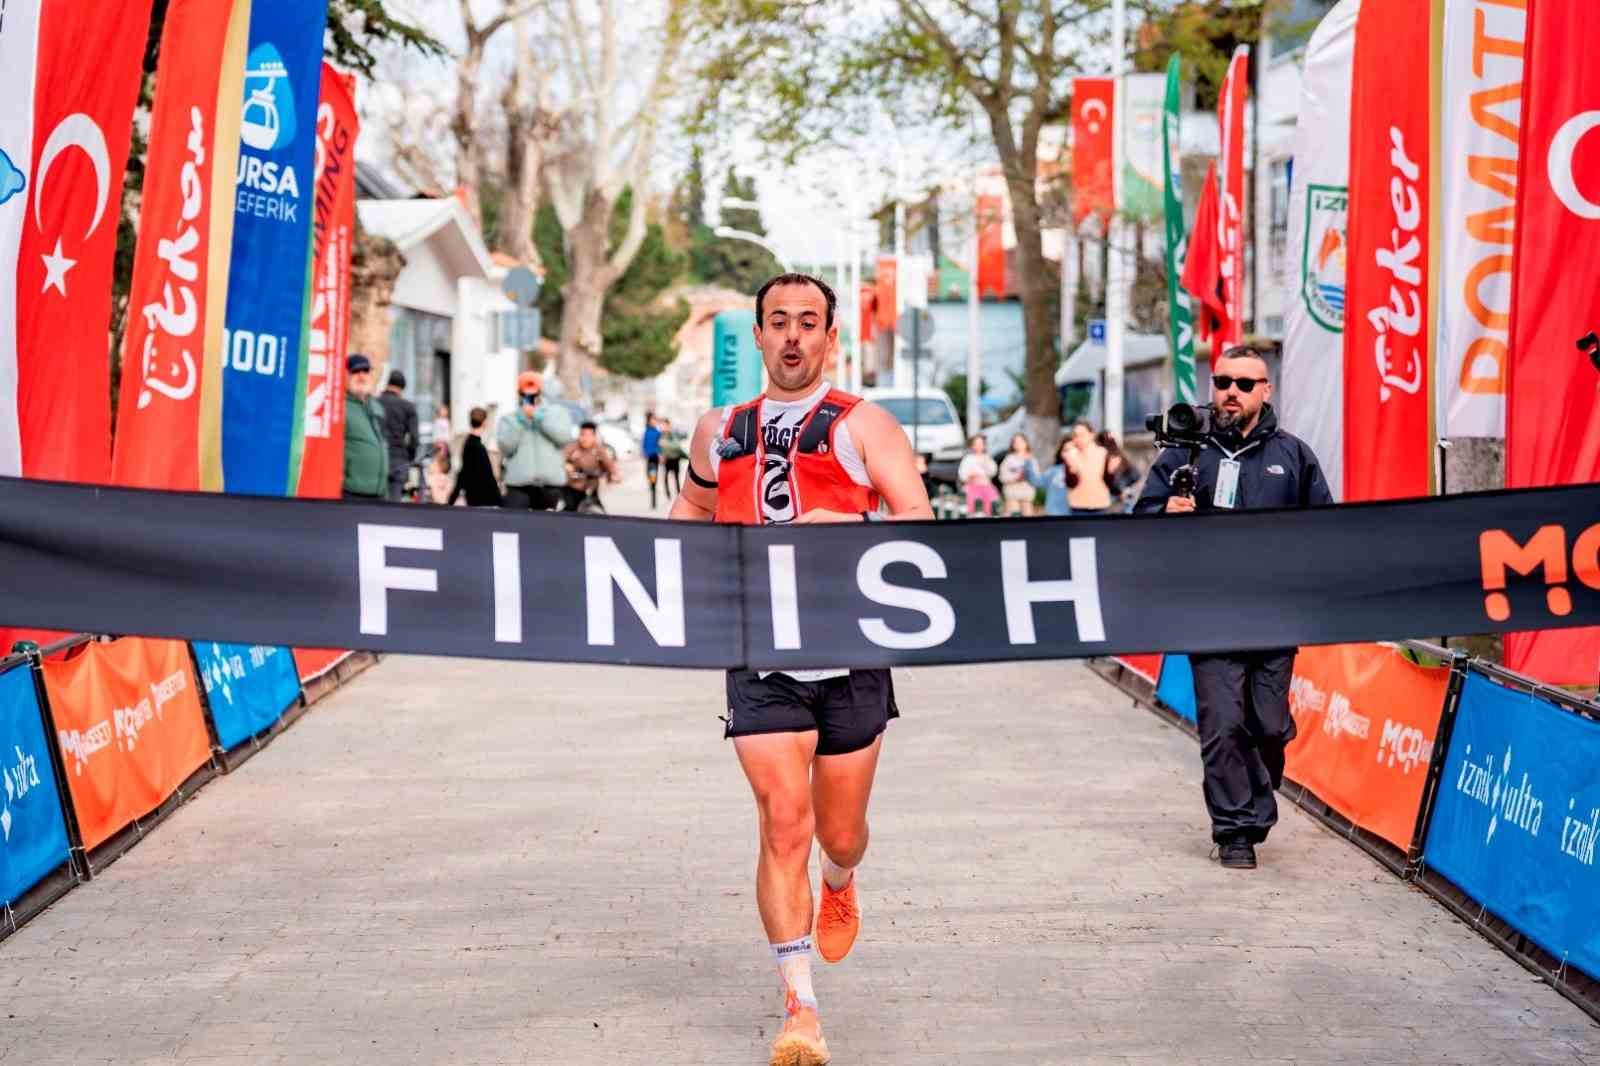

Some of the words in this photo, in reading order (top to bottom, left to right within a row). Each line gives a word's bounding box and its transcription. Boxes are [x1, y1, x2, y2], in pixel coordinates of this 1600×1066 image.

[718, 334, 737, 390] ultra
[357, 522, 1107, 651] FINISH
[1503, 772, 1544, 837] ultra
